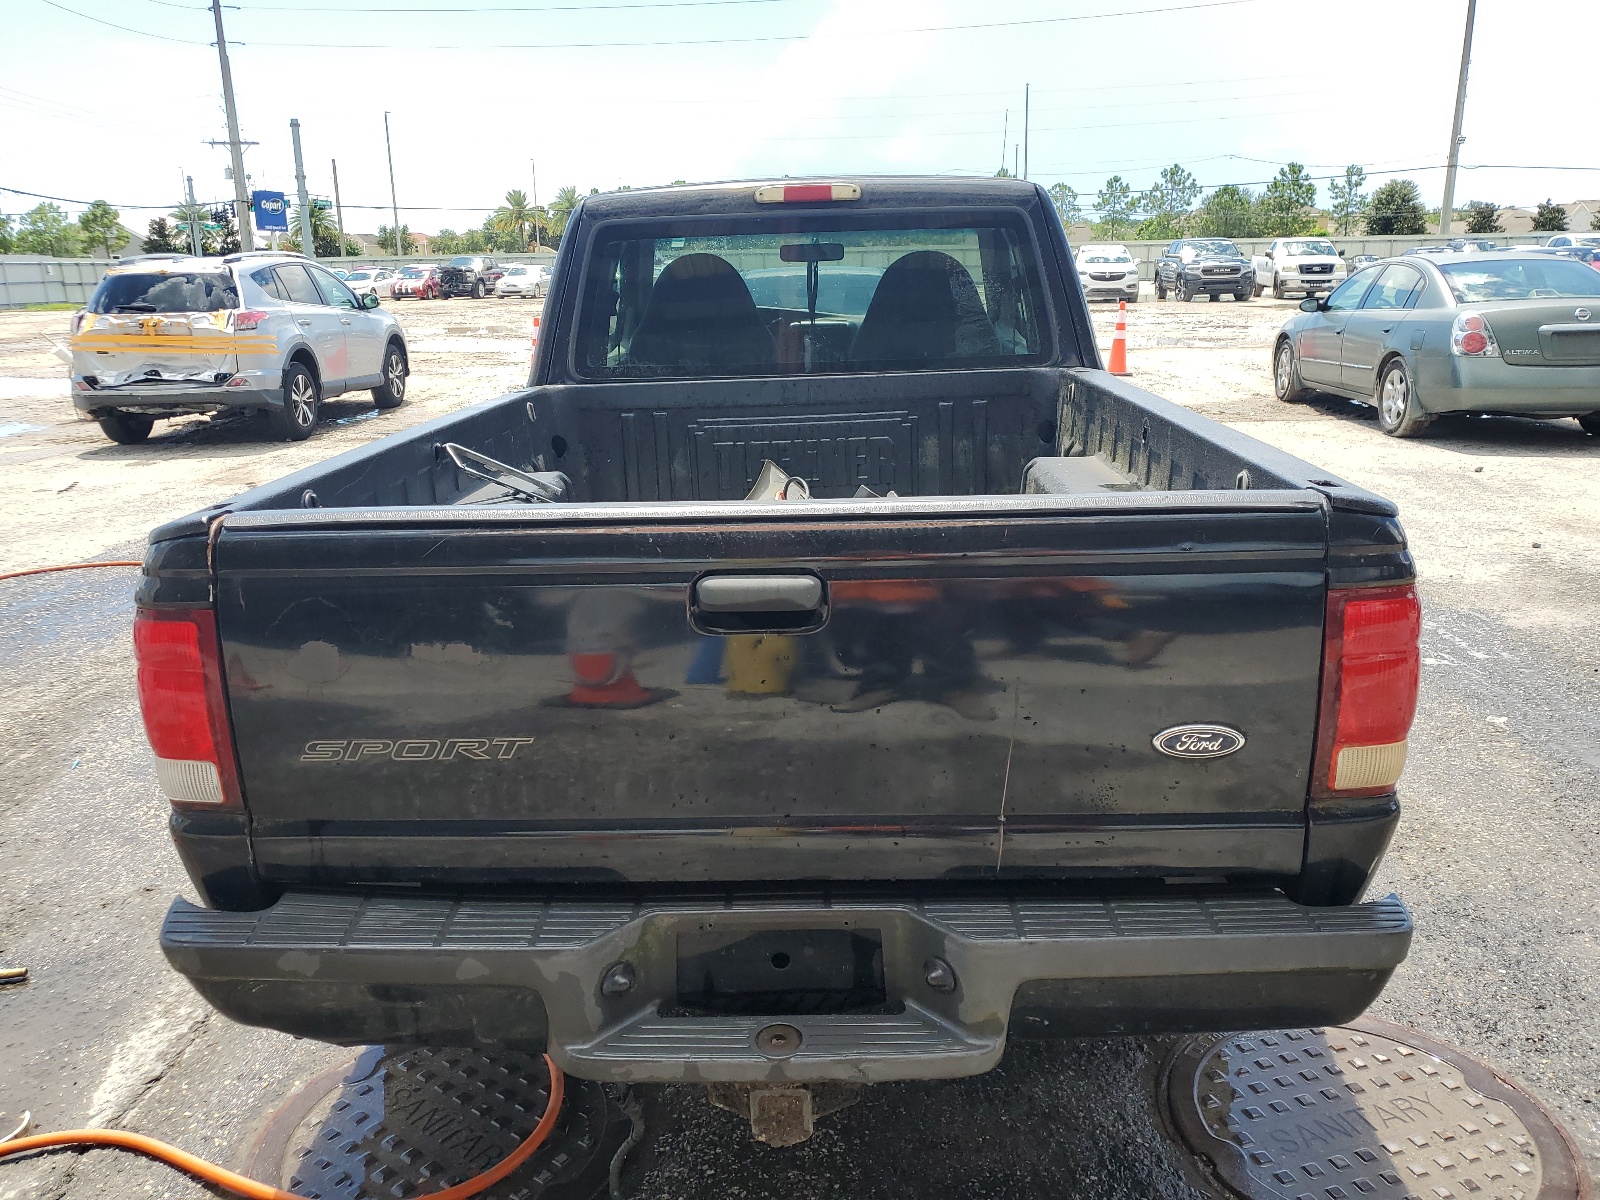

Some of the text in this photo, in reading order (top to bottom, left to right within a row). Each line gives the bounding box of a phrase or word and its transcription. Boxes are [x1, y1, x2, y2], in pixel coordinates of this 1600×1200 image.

[261, 200, 281, 211] Copart
[299, 737, 535, 762] SPORT
[1176, 733, 1224, 751] Ford
[1271, 1091, 1447, 1154] SANITARY
